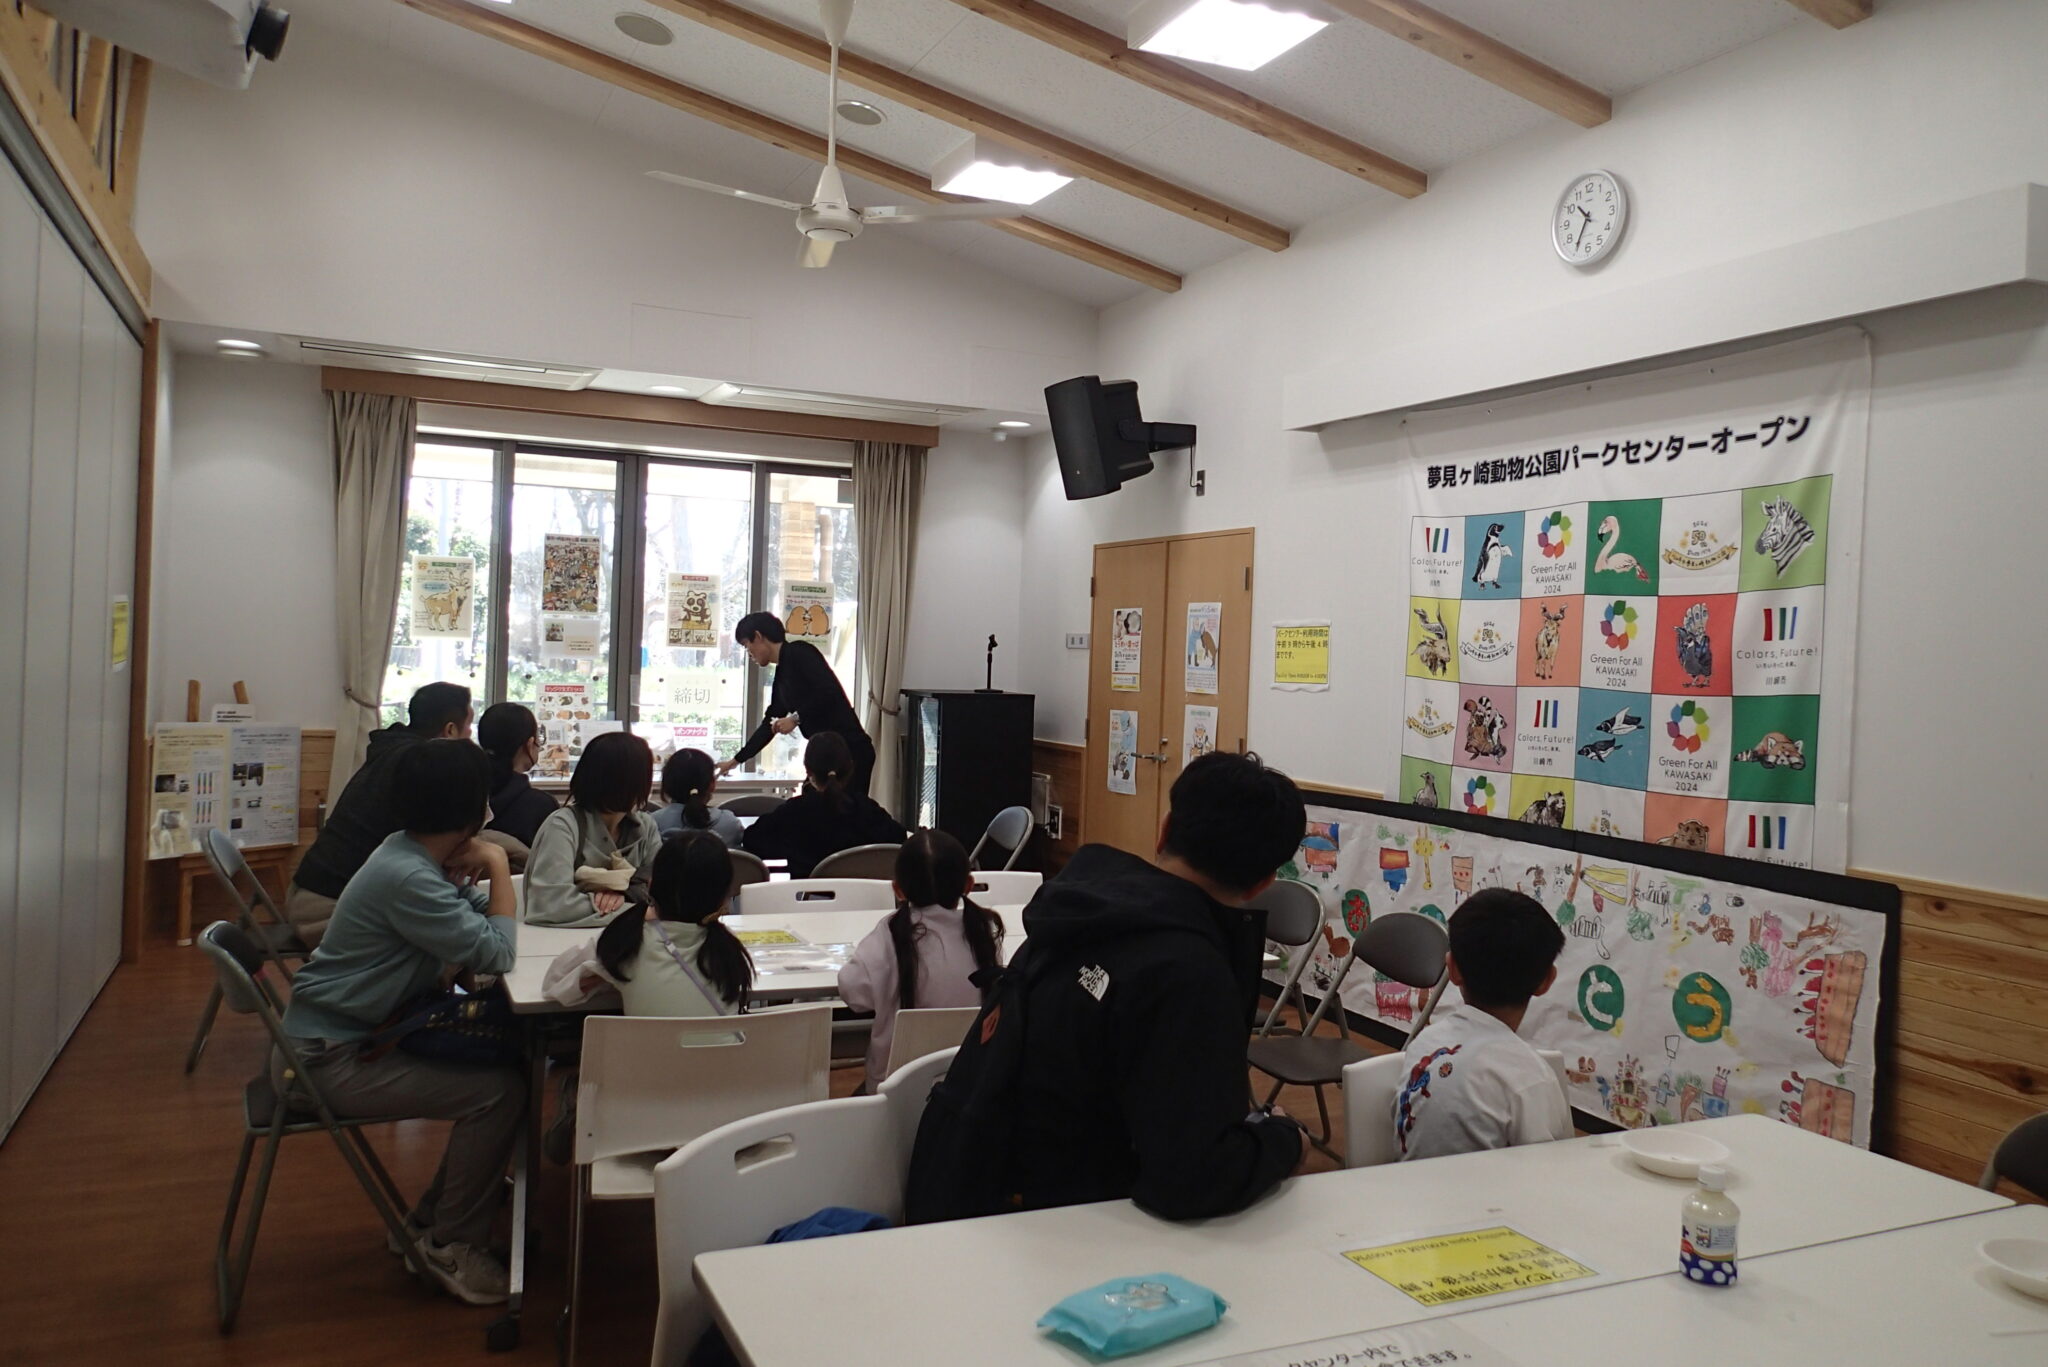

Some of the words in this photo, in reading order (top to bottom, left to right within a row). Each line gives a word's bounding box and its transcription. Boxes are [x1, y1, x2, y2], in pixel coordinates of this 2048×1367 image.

[1585, 182, 1594, 193] 12
[1575, 191, 1582, 201] 11
[1605, 191, 1612, 202] 2
[1567, 203, 1576, 214] 10
[1608, 205, 1615, 216] 3
[1563, 219, 1570, 230] 9
[1604, 221, 1611, 231] 4
[1566, 233, 1573, 244] 8
[1596, 234, 1603, 245] 5
[1584, 243, 1592, 253] 6
[1427, 414, 1811, 489] 夢見ヶ崎動物公園パークセンターオープン
[1530, 565, 1553, 574] Green
[1554, 562, 1567, 572] For
[1567, 561, 1577, 570] All
[1536, 573, 1572, 584] KAWASAKI
[1543, 584, 1561, 594] 2024
[1590, 653, 1618, 664] Green
[1619, 656, 1632, 666] For
[1632, 656, 1643, 666] All
[1595, 665, 1637, 677] KAWASAKI
[1606, 677, 1627, 687] 2024
[1543, 734, 1575, 744] Future!
[1658, 756, 1686, 768] Green
[1688, 758, 1704, 769] For
[1705, 759, 1718, 769] All
[1664, 769, 1712, 781] KAWASAKI
[1675, 781, 1698, 792] 2024
